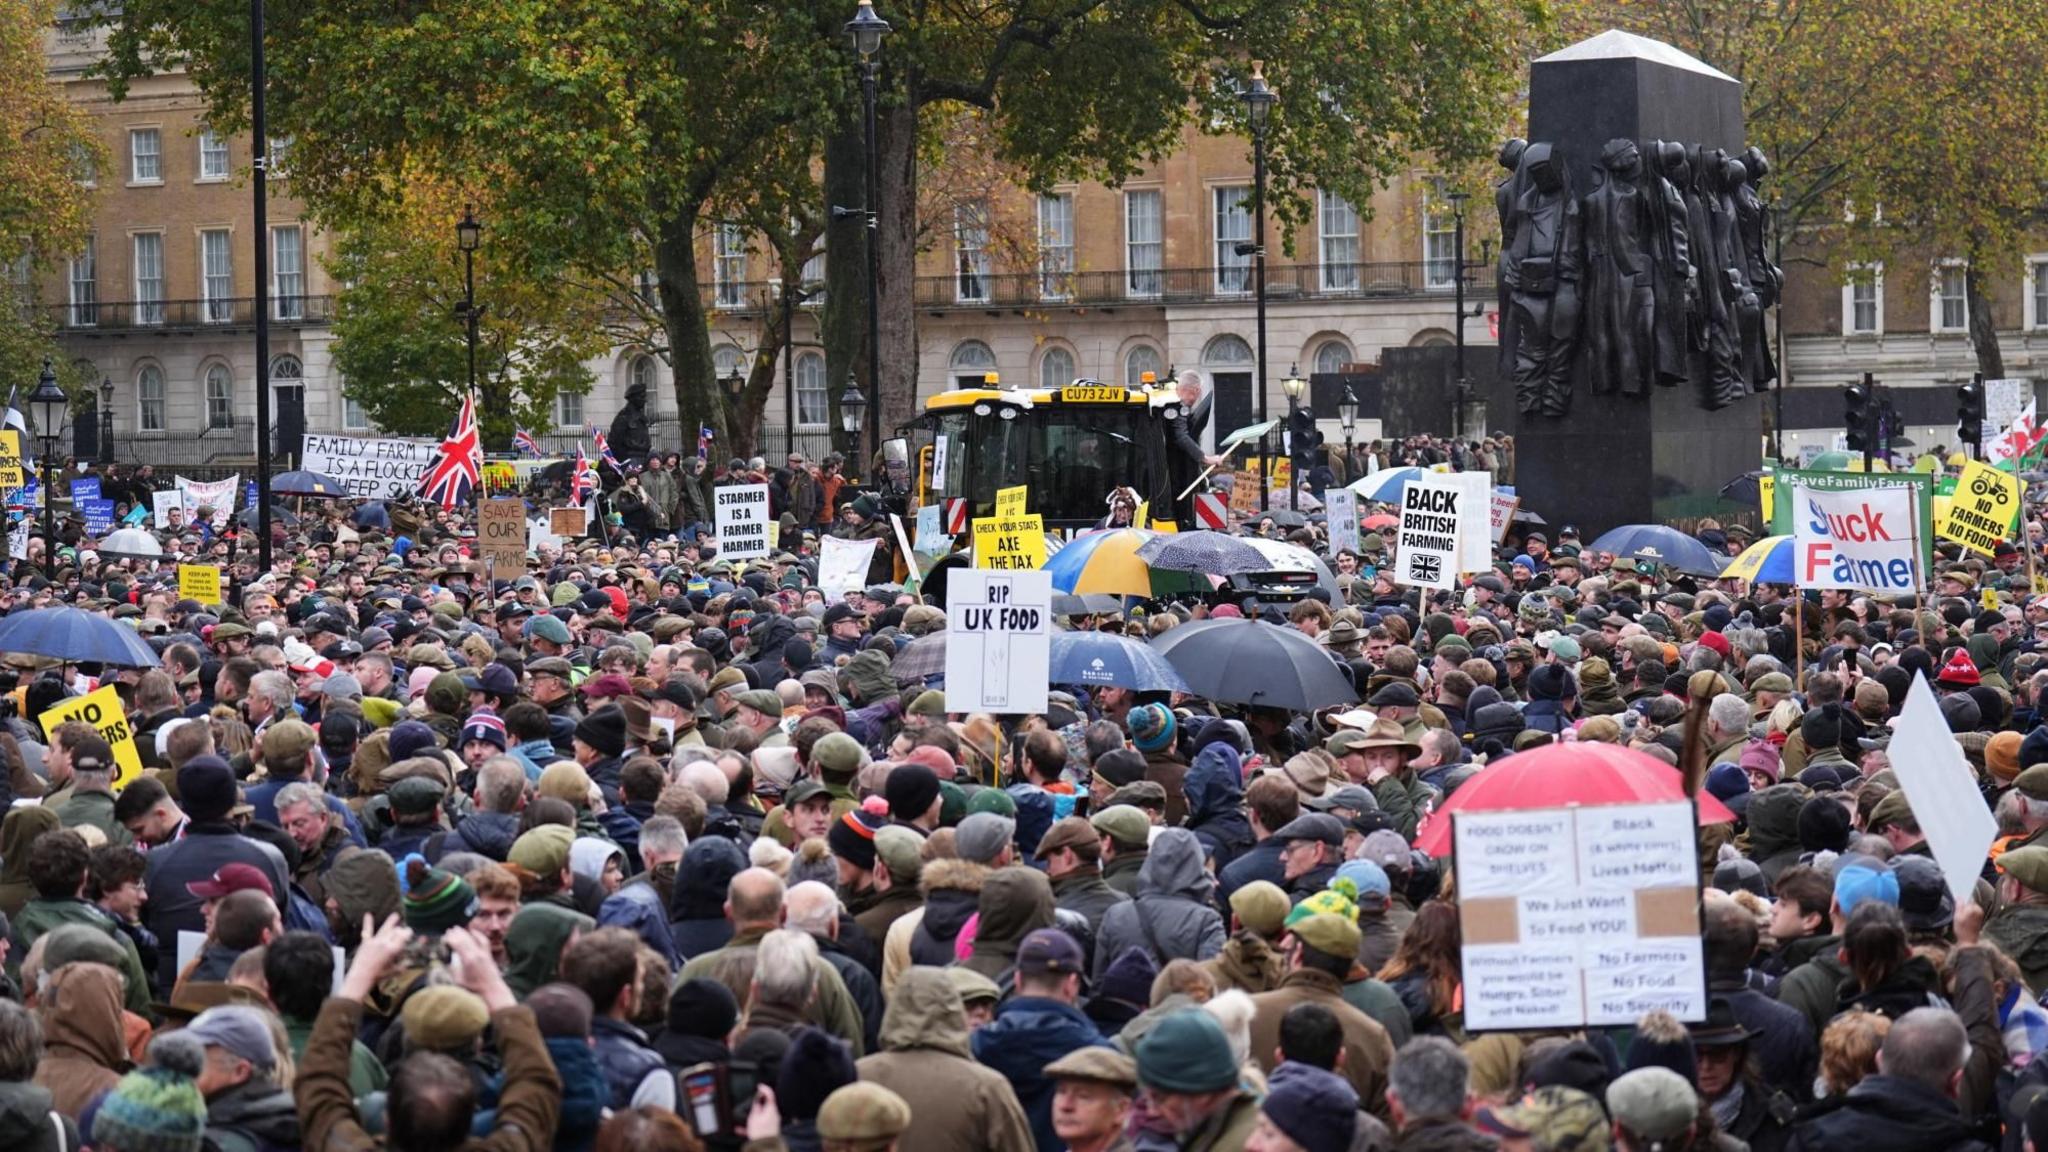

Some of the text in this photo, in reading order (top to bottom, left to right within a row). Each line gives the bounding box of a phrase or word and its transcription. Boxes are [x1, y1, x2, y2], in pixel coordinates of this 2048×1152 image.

[1066, 388, 1120, 400] CU73 ZJV
[306, 437, 369, 457] FAMILY
[376, 441, 416, 460] FARM
[323, 457, 429, 480] IS A FLOCKI
[332, 477, 380, 497] HEEP
[1780, 473, 1925, 491] #SaveFamilyFars
[718, 491, 765, 505] STARMER
[1405, 486, 1459, 515] BACK
[483, 504, 521, 520] SAVE
[1974, 498, 1993, 514] NO
[731, 508, 751, 520] IS A
[1950, 506, 2005, 537] FARMERS
[487, 521, 518, 538] OUR
[723, 523, 763, 537] FARMER
[976, 520, 1039, 534] CHECK YOUR STATS
[1403, 513, 1457, 535] BRITISH
[1946, 522, 1965, 537] NO
[722, 539, 764, 553] HARMER
[998, 536, 1020, 552] AXE
[1401, 532, 1454, 552] FARMING
[988, 554, 1034, 570] THE TAX
[988, 585, 1010, 604] RIP
[965, 607, 1039, 631] UK FOOD
[1466, 825, 1504, 837] FOOD
[1612, 818, 1655, 830] Black
[1485, 842, 1549, 855] GROW ON
[1490, 861, 1547, 875] SHELVES
[1592, 862, 1682, 877] Lives Matter
[1526, 897, 1626, 912] We Just Want
[1530, 920, 1627, 935] To Feed YOU!
[1470, 955, 1573, 967] Without Farmers
[1598, 952, 1687, 966] No Farmers
[1507, 971, 1544, 981] would
[1548, 971, 1564, 980] be
[1612, 975, 1676, 988] No Food
[1601, 1000, 1690, 1014] No Security
